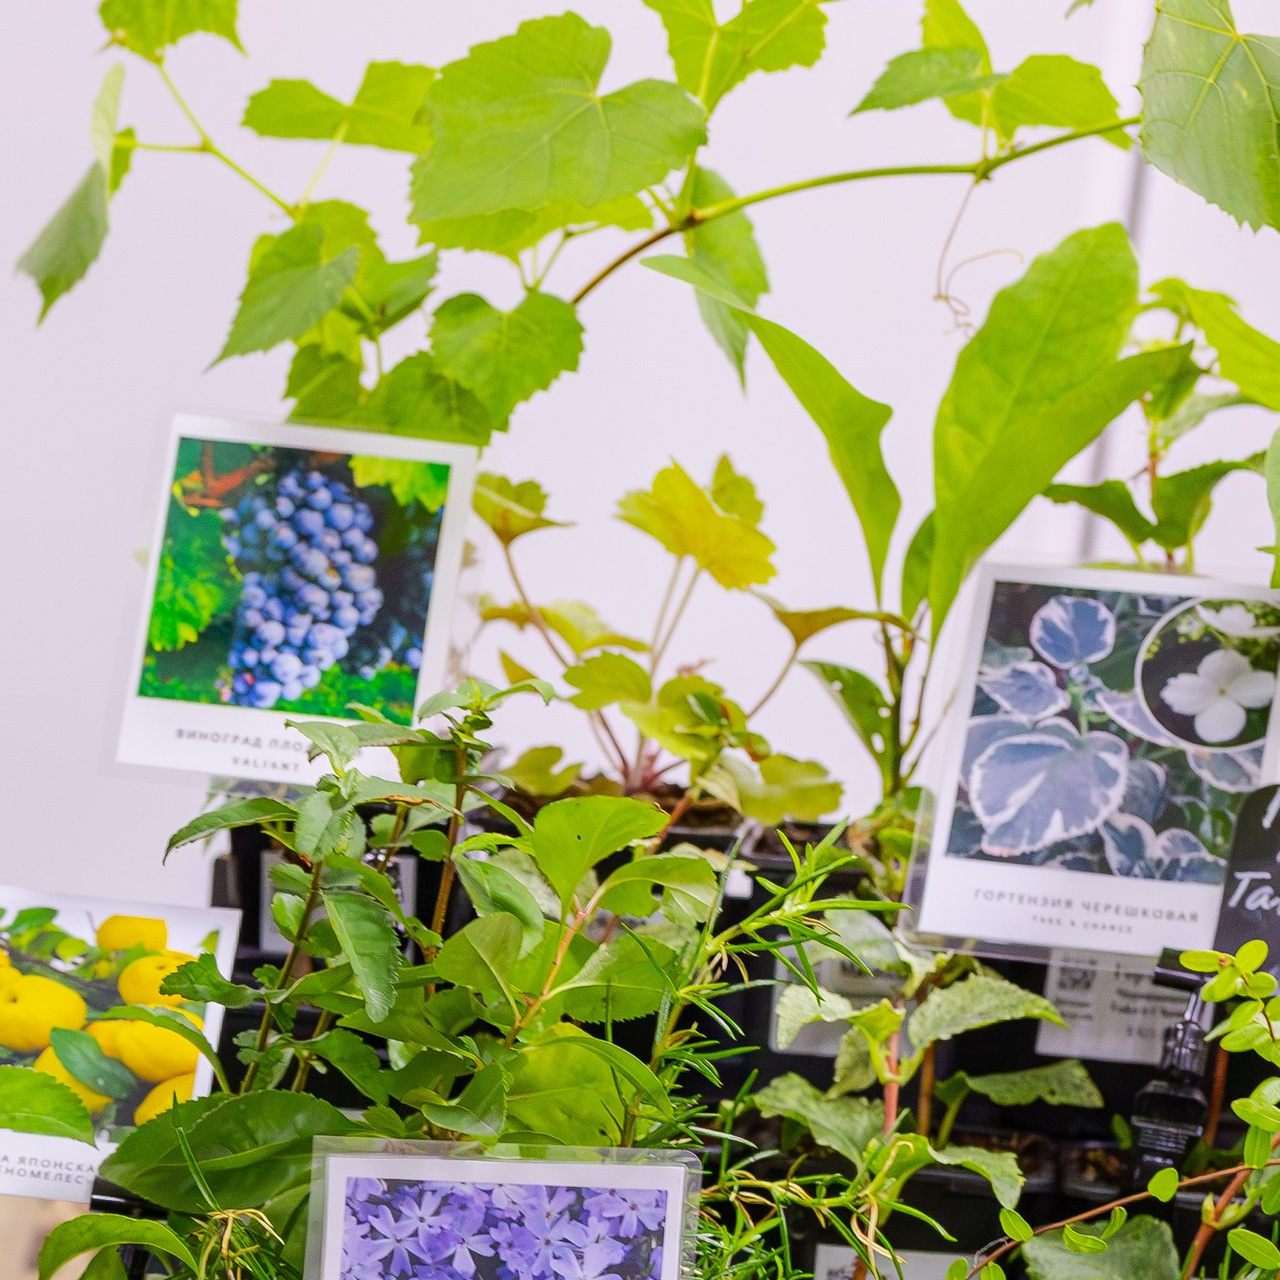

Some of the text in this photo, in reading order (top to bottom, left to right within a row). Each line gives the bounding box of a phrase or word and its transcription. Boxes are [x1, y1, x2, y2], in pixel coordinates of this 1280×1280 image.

[176, 729, 262, 748] ВИНОГРАД
[232, 756, 300, 772] VALIANT
[973, 887, 1199, 923] ГОРТЕНЗИЯ ЧЕРЕШКОВАЯ
